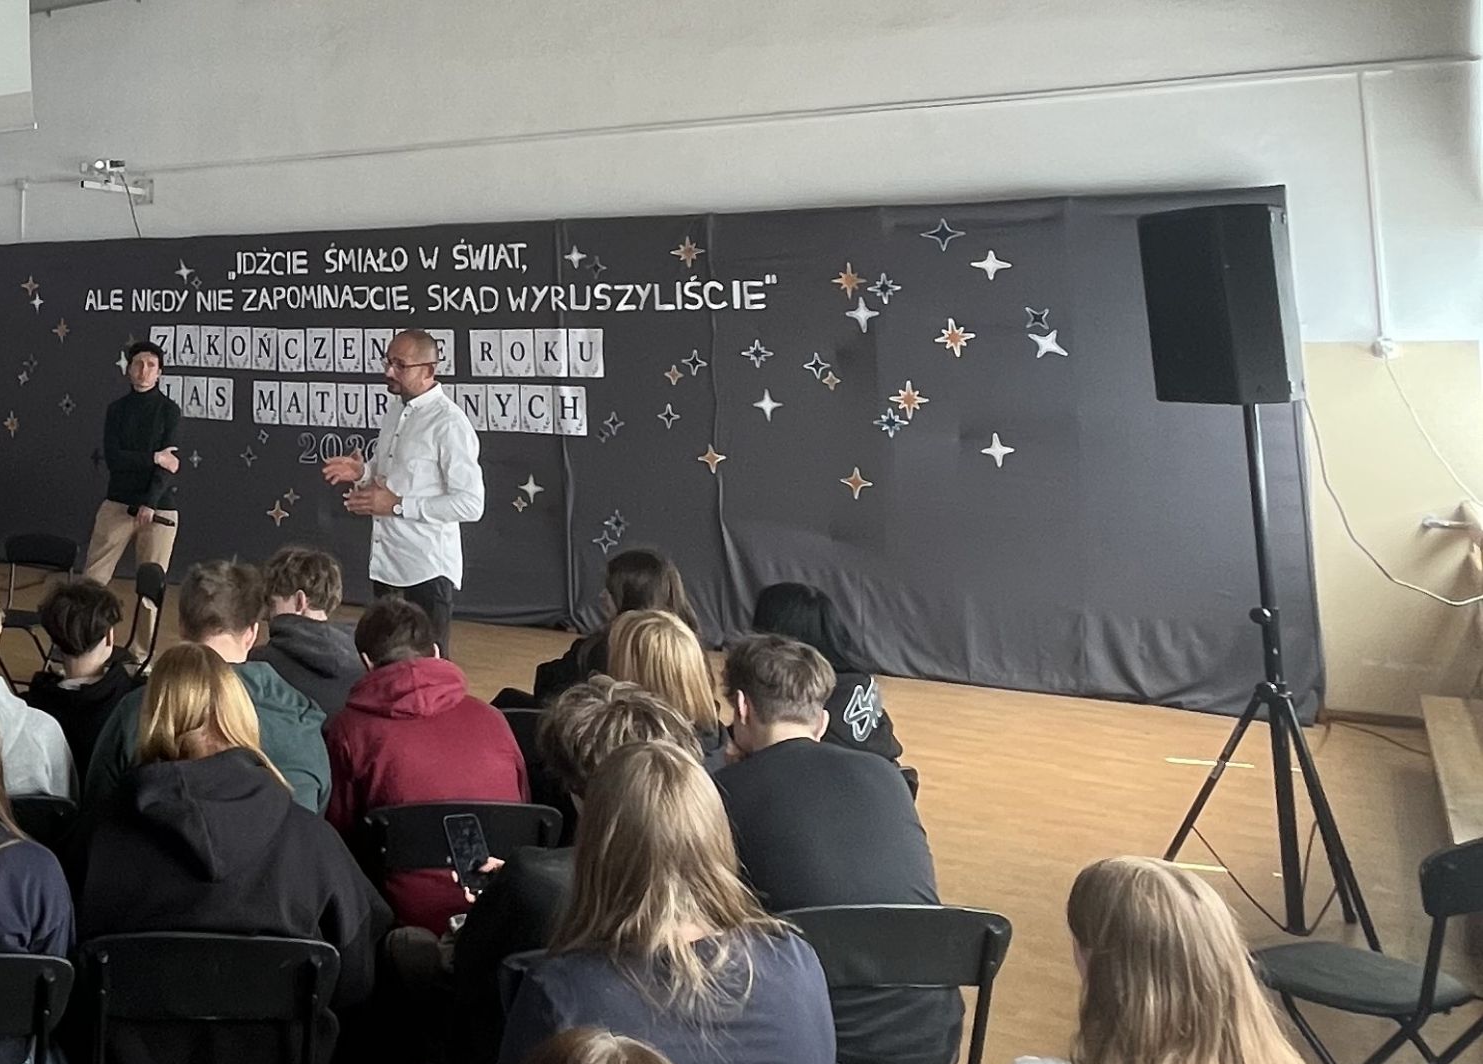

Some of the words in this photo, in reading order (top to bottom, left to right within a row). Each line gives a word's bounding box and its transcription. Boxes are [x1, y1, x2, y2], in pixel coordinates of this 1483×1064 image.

[325, 242, 408, 273] ŚMIAŁO
[419, 246, 439, 270] W
[452, 239, 528, 274] ŚWIAT,
[84, 289, 124, 312] ALE
[131, 288, 189, 313] NIGDY
[196, 288, 233, 312] NIE
[242, 284, 416, 314] ZAPOMINAJCIE,
[427, 284, 499, 316] SKĄD
[156, 333, 447, 362] ZAKOŃCZENE
[480, 341, 594, 362] ROKU
[256, 389, 579, 420] MATURNYCH
